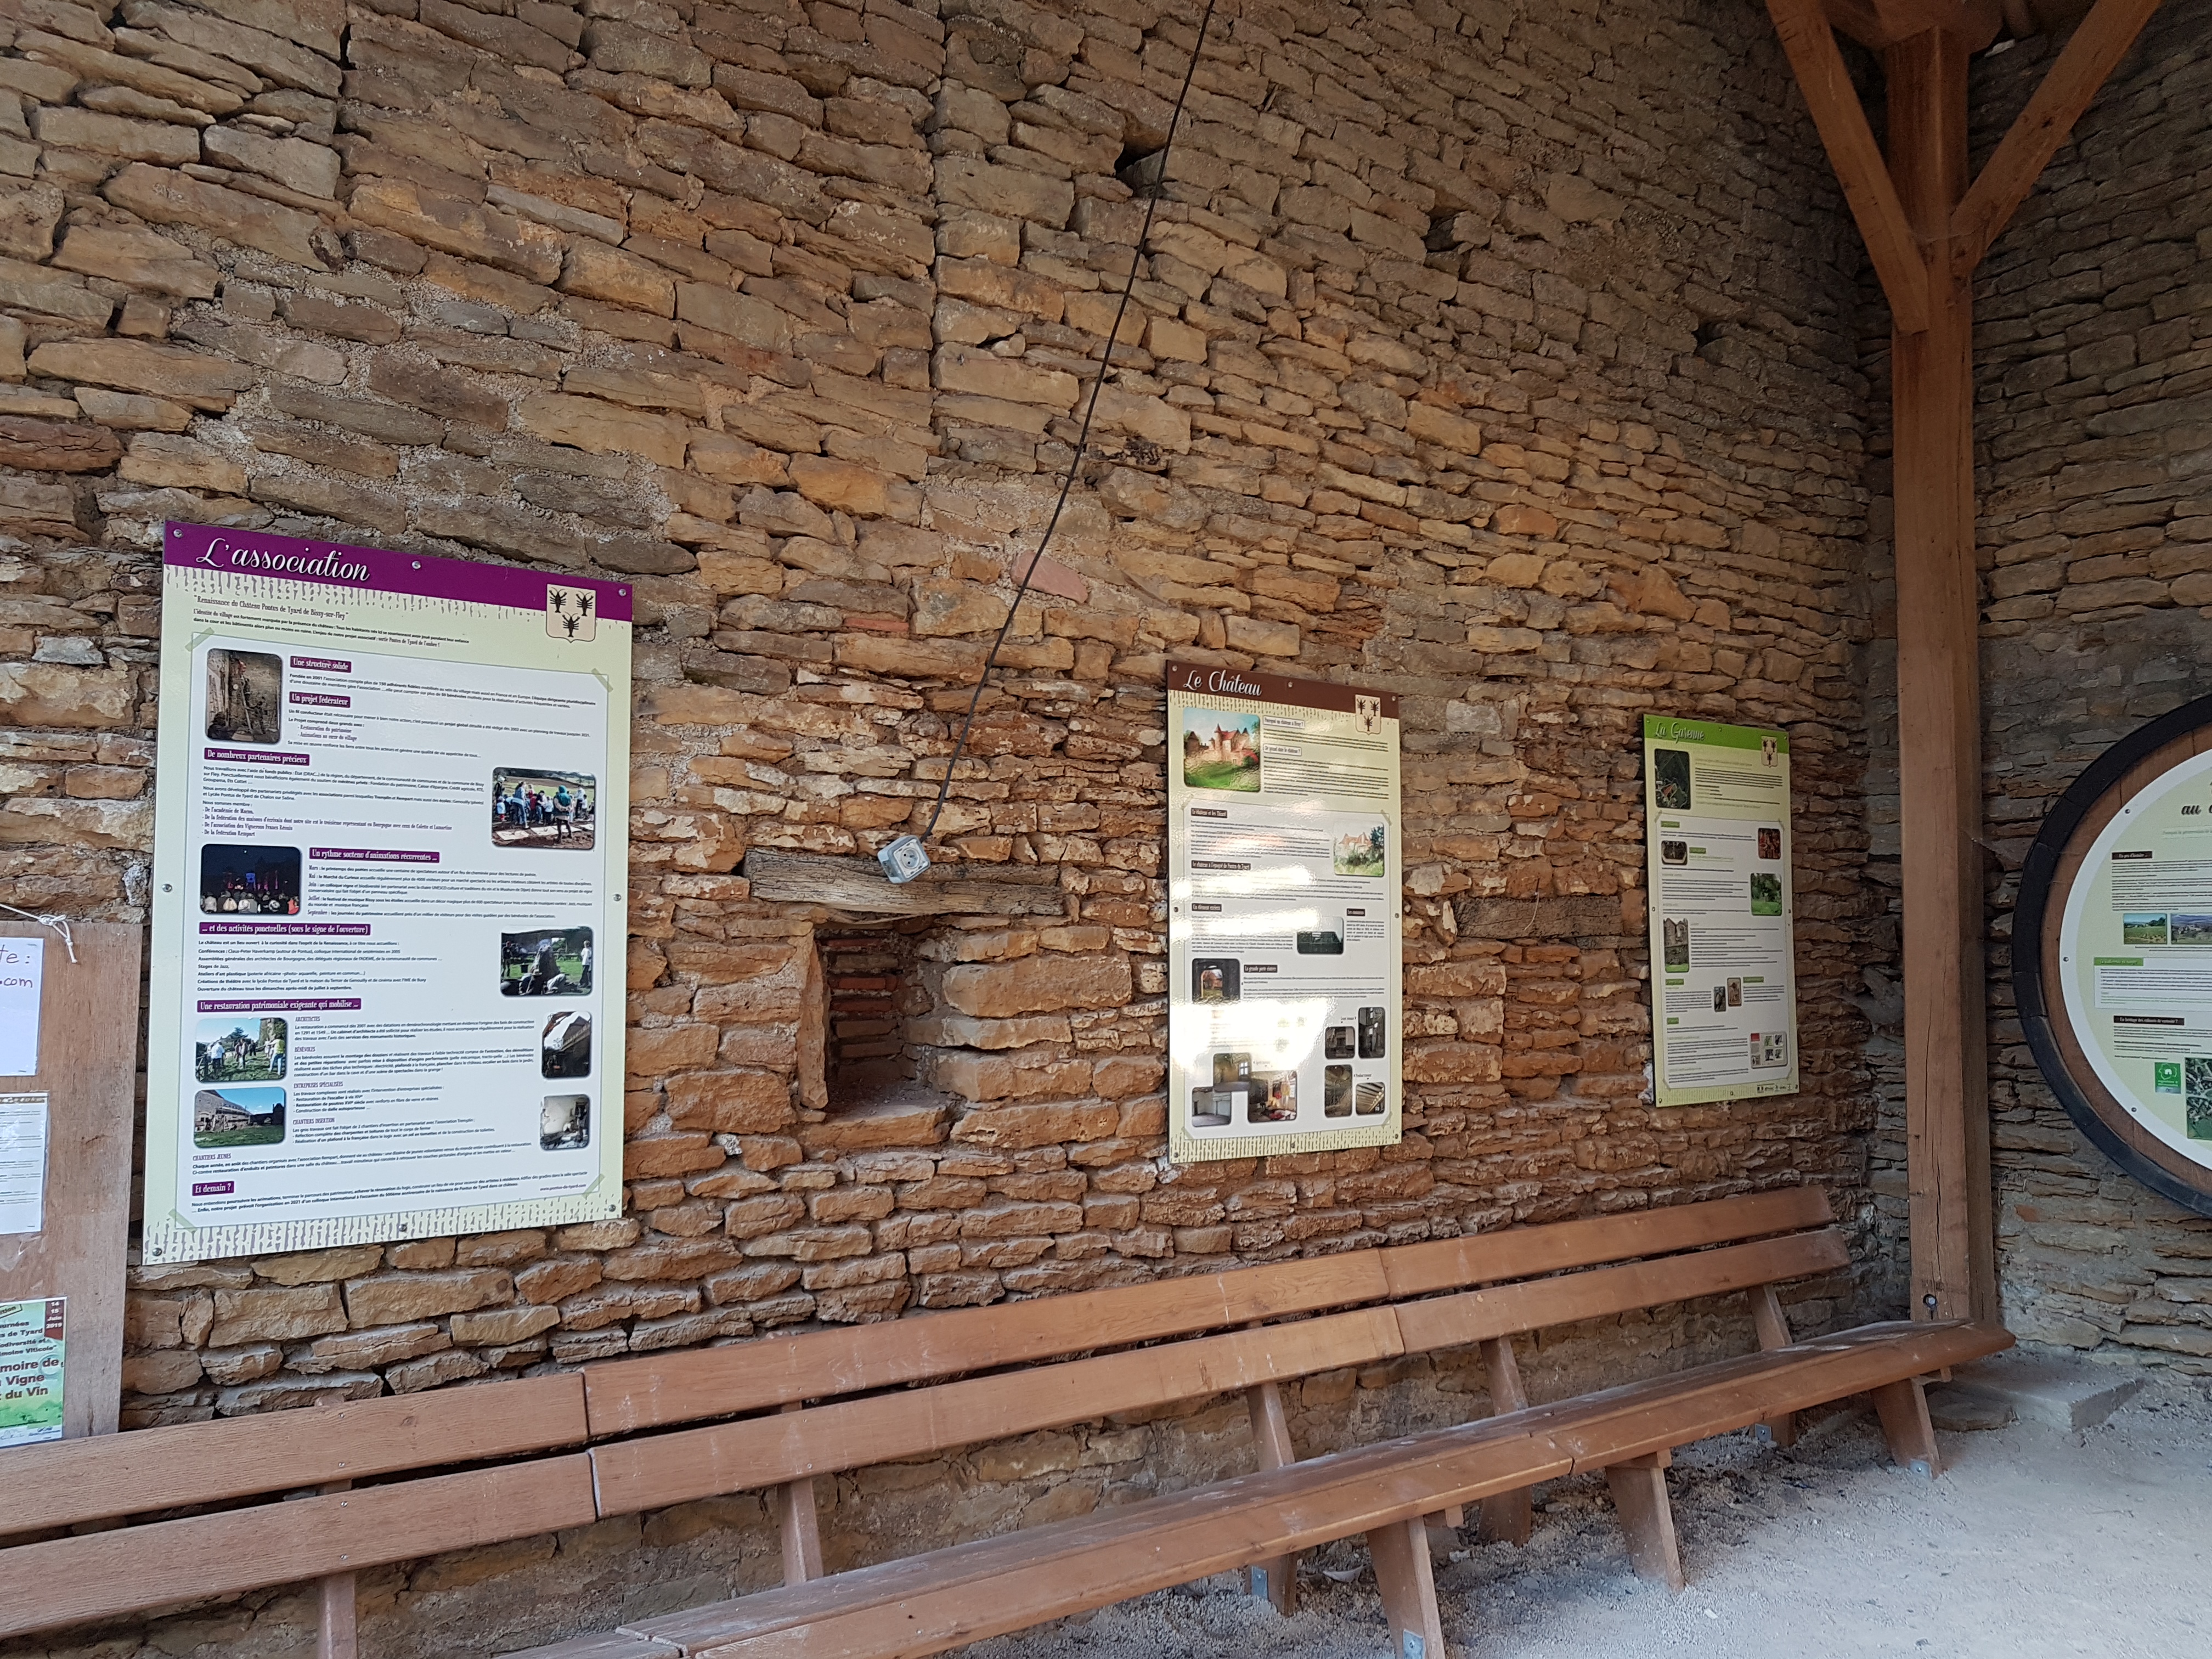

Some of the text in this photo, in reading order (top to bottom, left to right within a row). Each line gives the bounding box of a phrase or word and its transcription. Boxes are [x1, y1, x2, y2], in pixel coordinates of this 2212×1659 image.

[196, 538, 370, 581] L'association
[239, 600, 260, 609] Château
[262, 603, 278, 611] Pontus
[287, 606, 302, 615] Tyard
[294, 658, 348, 670] Une structure solide
[1183, 669, 1262, 696] Le Château
[292, 693, 348, 706] Un projet fédérateur
[1655, 722, 1705, 743] La Garenne
[217, 751, 246, 759] nombreux
[247, 753, 281, 762] partenaires
[282, 755, 307, 764] précieux
[2181, 805, 2202, 815] au
[321, 850, 342, 859] rythme
[365, 851, 399, 860] d'animations
[217, 924, 227, 932] des
[228, 924, 253, 932] activités
[255, 924, 287, 934] ponctuelles
[288, 924, 303, 934] (sous
[305, 924, 311, 933] le
[312, 926, 326, 934] signe
[336, 925, 368, 935] l'ouverture)
[214, 1001, 250, 1009] restauration
[252, 1001, 289, 1011] patrimoniale
[290, 1001, 317, 1010] exigeante
[318, 1001, 328, 1009] qui
[329, 1000, 352, 1008] mobilise
[195, 1183, 231, 1193] Et demain ?
[20, 1328, 43, 1336] Tyard
[0, 1357, 59, 1373] moire de
[5, 1374, 44, 1386] Vigne
[5, 1386, 48, 1400] du Vin
